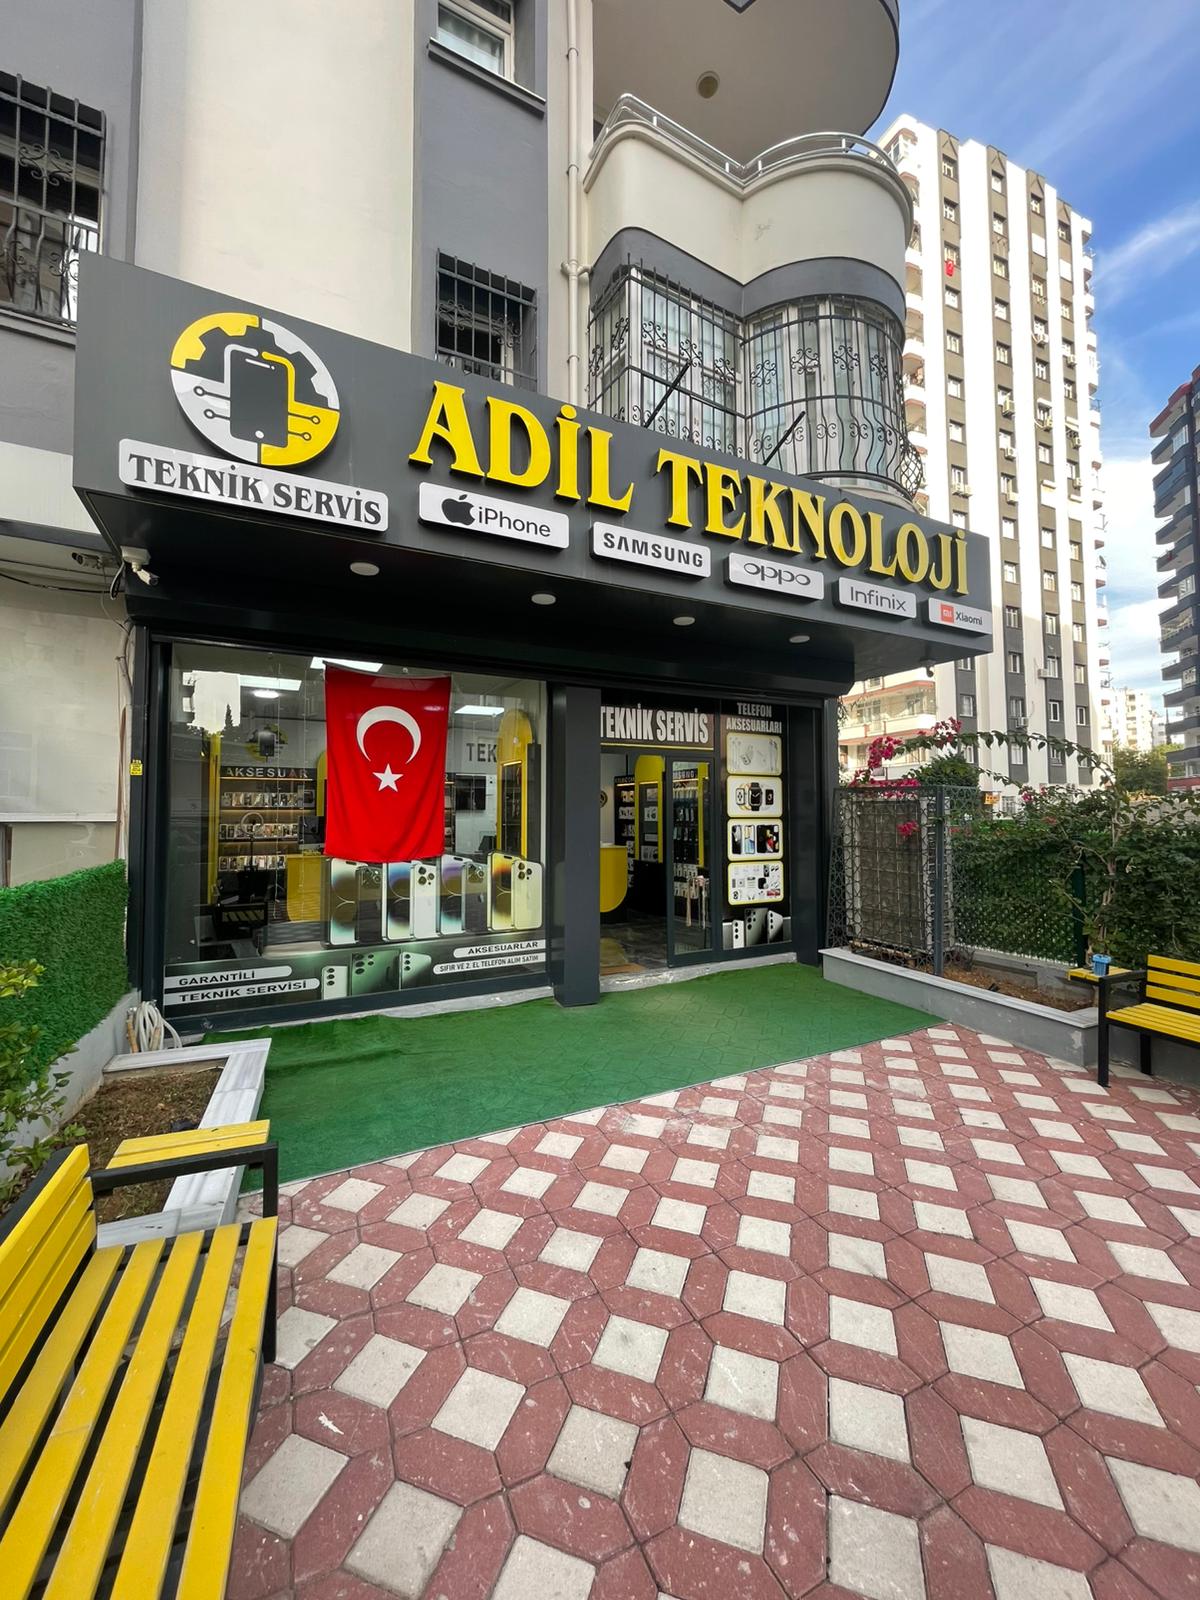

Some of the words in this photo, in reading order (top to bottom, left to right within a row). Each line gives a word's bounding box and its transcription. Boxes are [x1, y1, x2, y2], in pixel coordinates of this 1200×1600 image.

[128, 453, 263, 504] TEKNİK
[273, 483, 381, 526] SERVİS
[408, 380, 635, 512] ADİL
[655, 448, 969, 595] TEKNOLOJİ
[478, 506, 551, 537] iPhone
[603, 532, 703, 568] SAMSUNG
[850, 586, 906, 612] Infinix
[955, 611, 983, 626] Xiaomi
[736, 702, 773, 718] TELEFON
[656, 707, 709, 744] SERVİS
[726, 717, 782, 734] AKSESUARLARI
[226, 767, 308, 778] AKSESUAR
[468, 941, 538, 955] AKSESUARLAR
[456, 962, 466, 970] VE
[481, 958, 506, 968] TELEFON
[179, 970, 255, 986] GARANTİLİ
[179, 988, 240, 1003] TEKNİK
[246, 980, 307, 995] SERVİSİ
